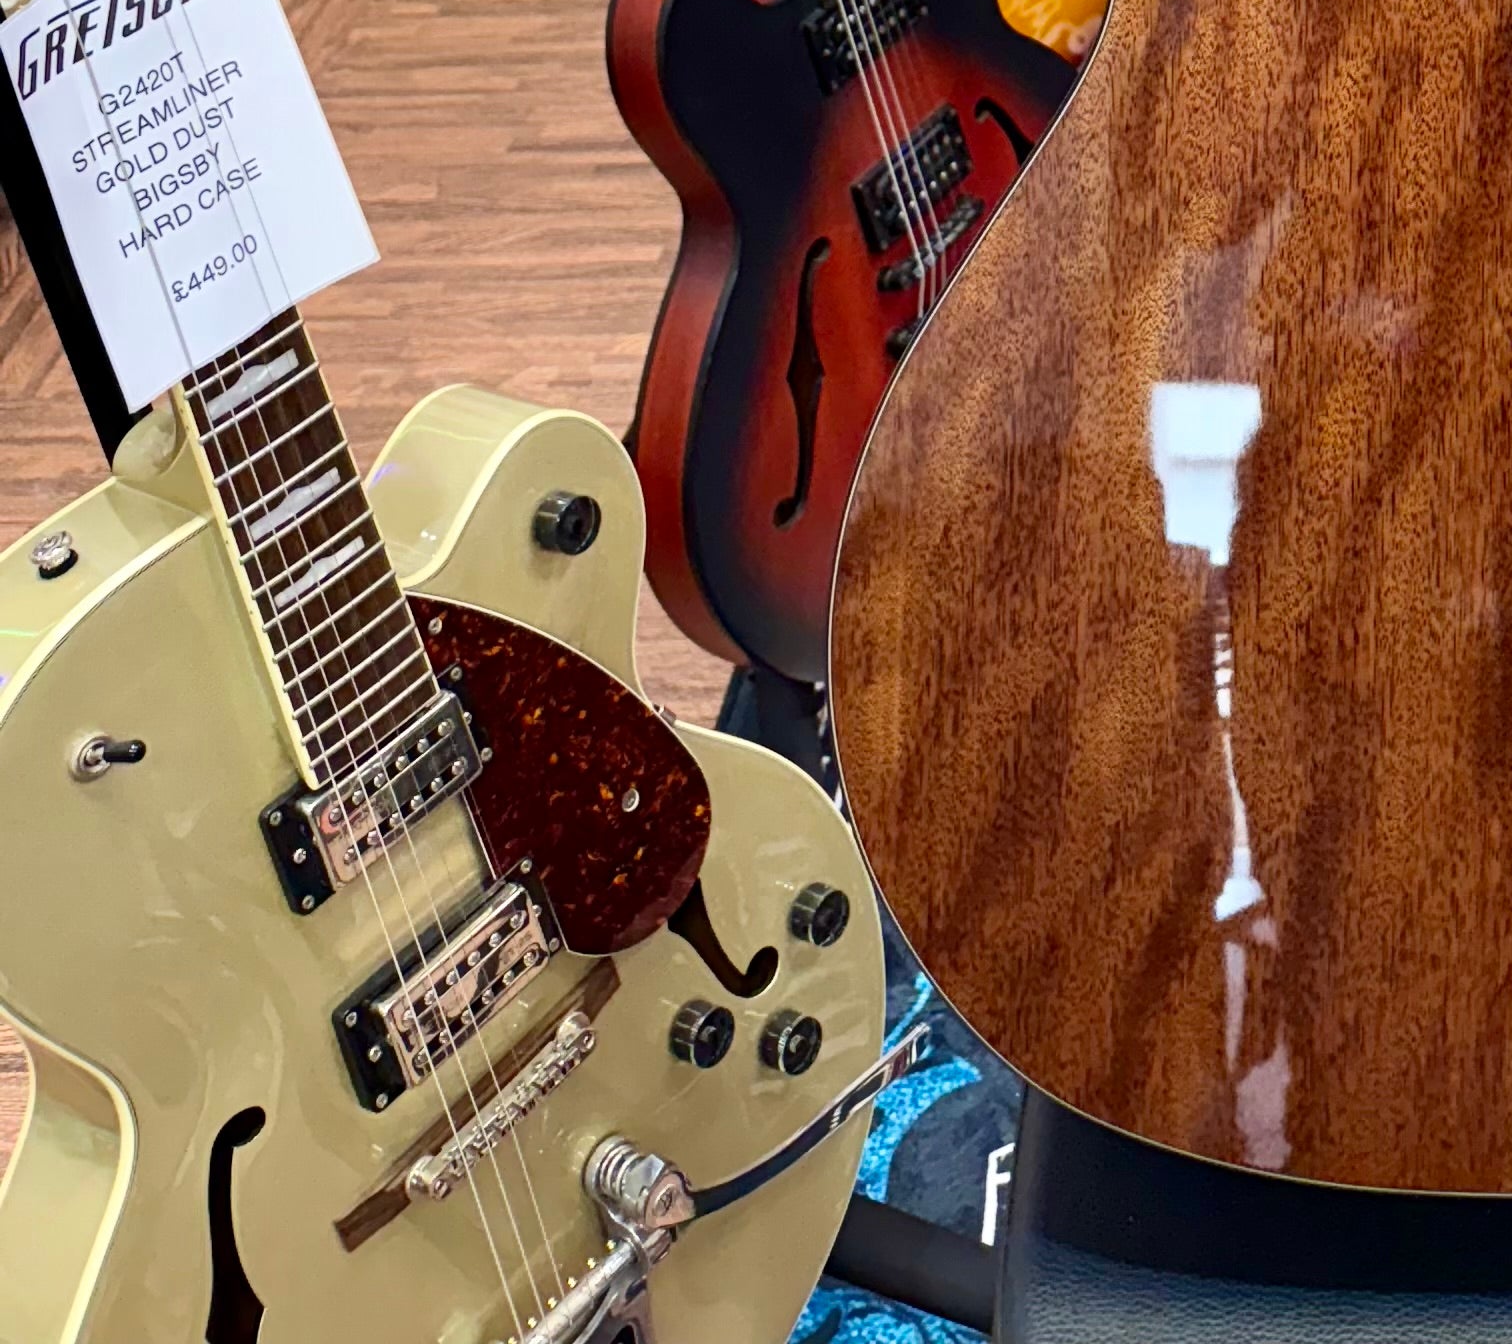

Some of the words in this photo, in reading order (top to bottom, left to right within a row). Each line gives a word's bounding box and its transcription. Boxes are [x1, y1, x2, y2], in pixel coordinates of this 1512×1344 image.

[72, 59, 243, 174] STREAMLINER
[98, 51, 187, 116] G2420T
[96, 141, 169, 194] GOLD
[177, 96, 238, 152] DUST
[134, 142, 221, 212] BIGSBY
[118, 202, 193, 259] HARD
[199, 157, 263, 211] CASE
[172, 233, 258, 303] £449.00
